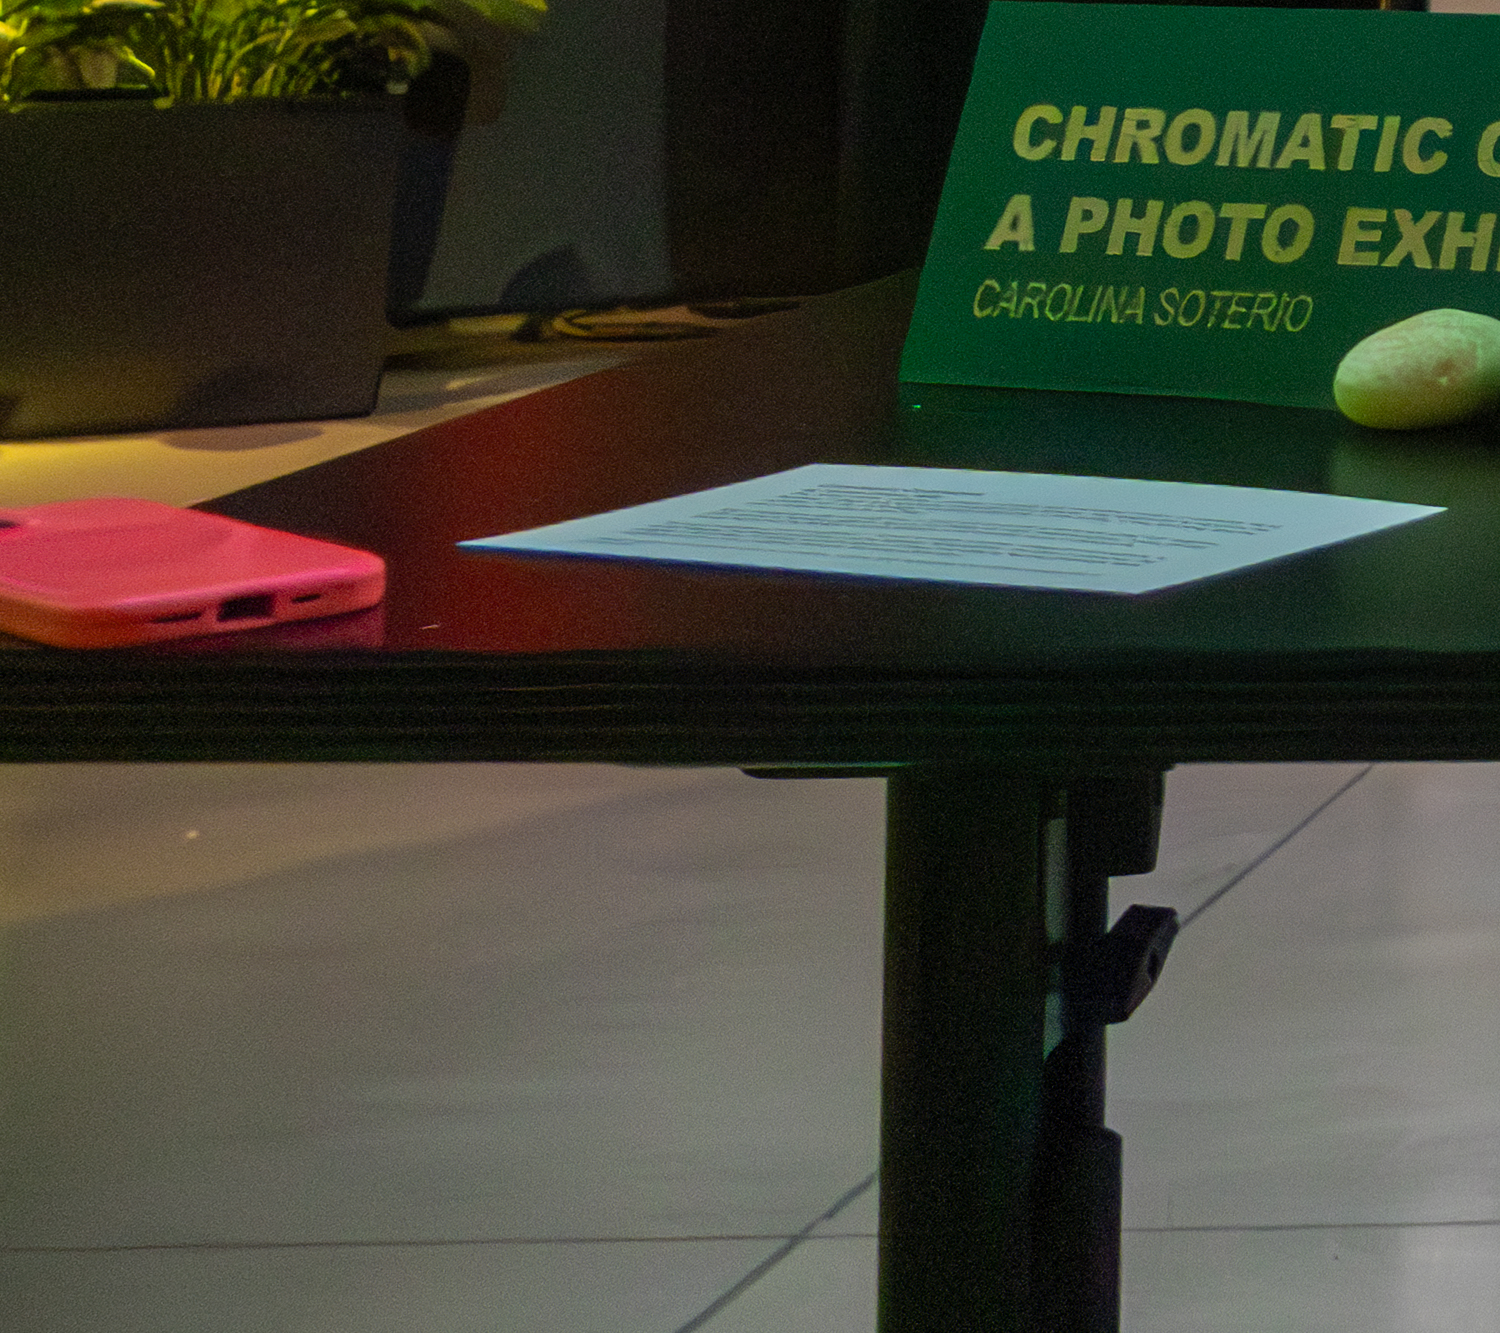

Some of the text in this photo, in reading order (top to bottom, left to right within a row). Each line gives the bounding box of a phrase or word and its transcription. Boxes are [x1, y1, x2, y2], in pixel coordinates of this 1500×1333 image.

[1012, 104, 1454, 175] CHROMATIC
[986, 194, 1035, 252] A
[1059, 196, 1315, 264] PHOTO
[973, 279, 1313, 332] CAROLINA SOTERIO
